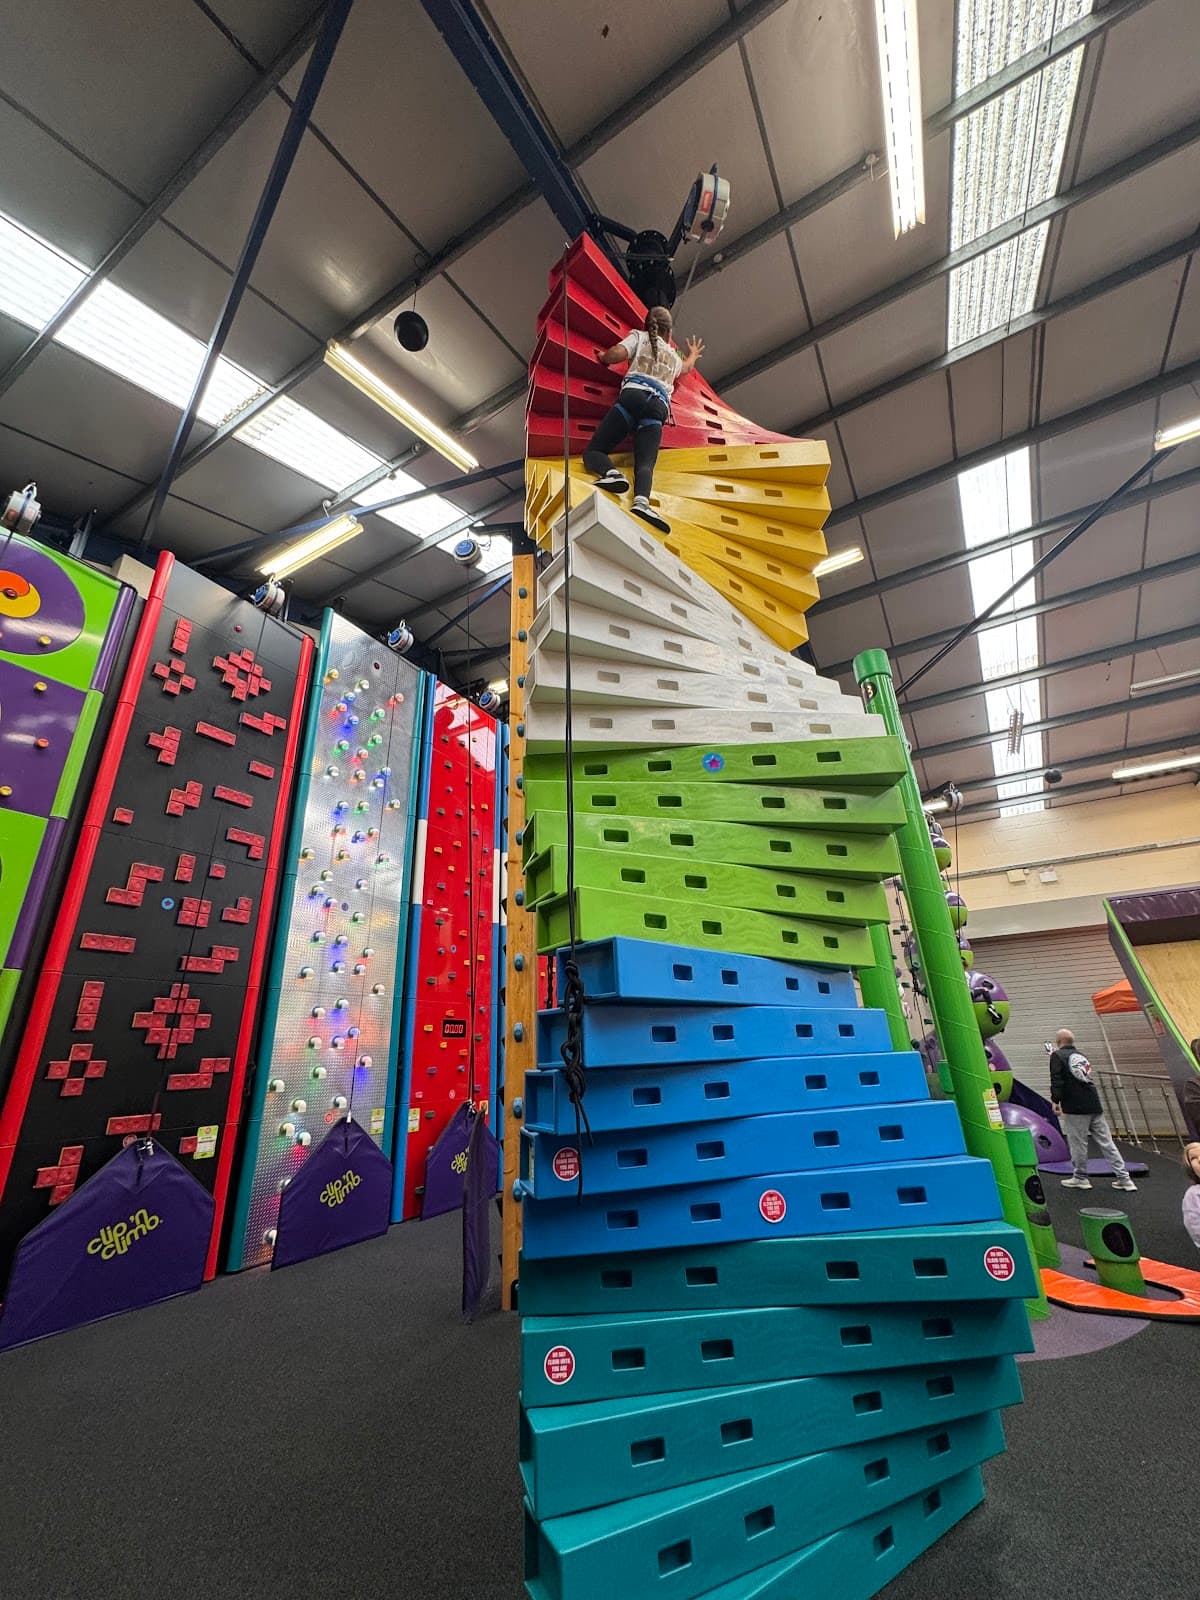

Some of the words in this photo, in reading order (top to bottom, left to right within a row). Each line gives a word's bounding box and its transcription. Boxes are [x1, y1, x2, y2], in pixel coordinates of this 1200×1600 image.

[320, 1180, 342, 1203] clip
[328, 1175, 361, 1207] climb
[87, 1222, 127, 1254] clip
[101, 1215, 159, 1260] climb
